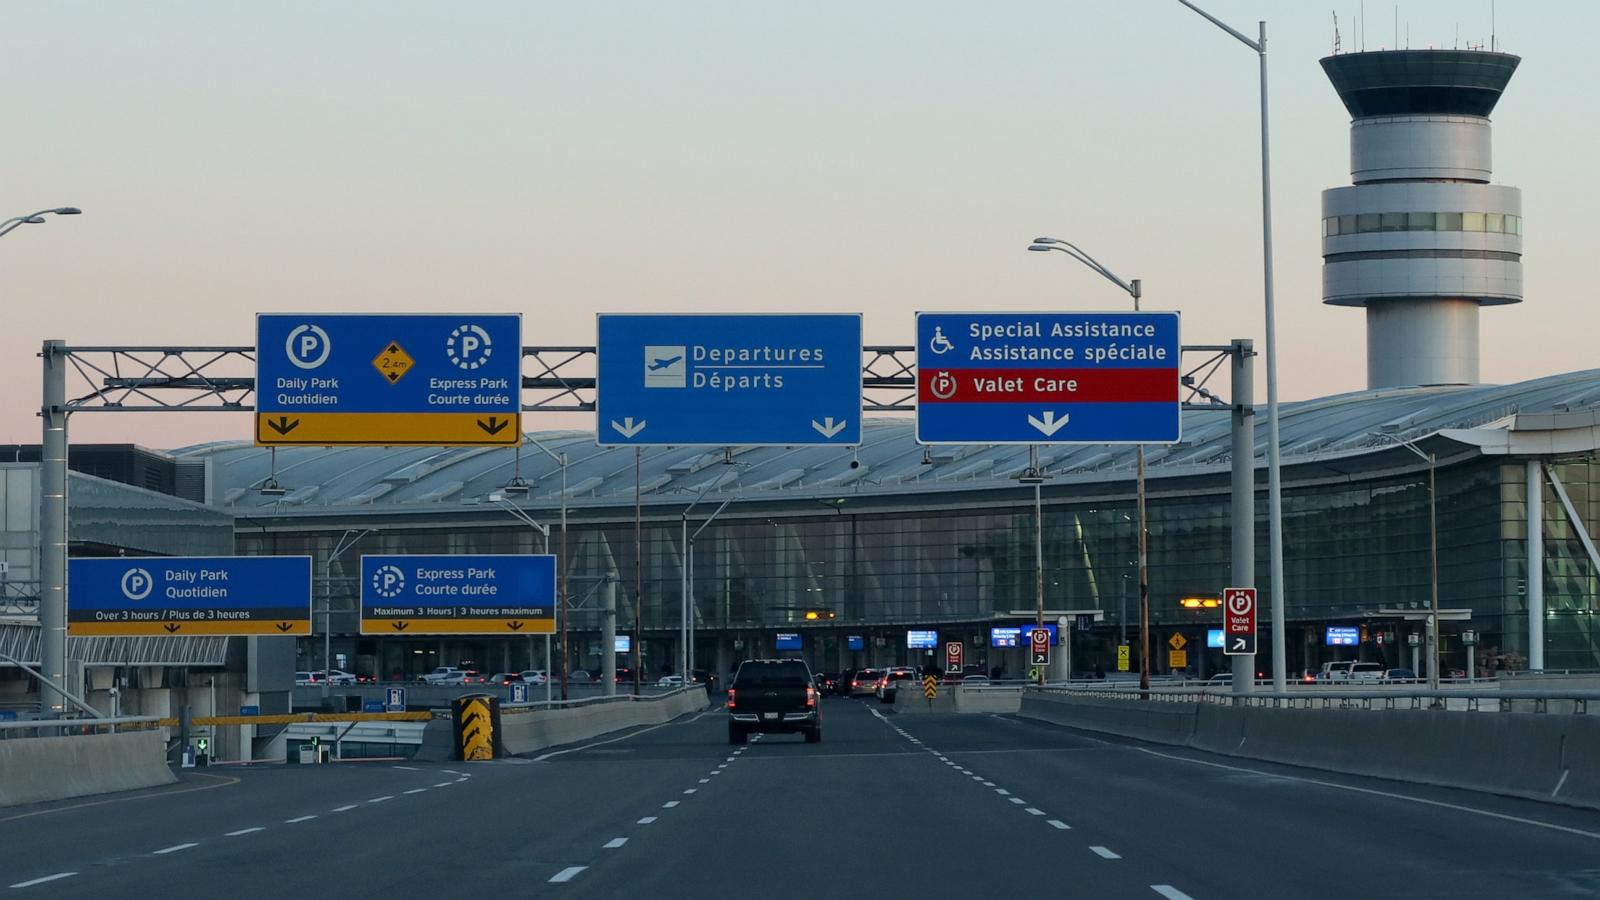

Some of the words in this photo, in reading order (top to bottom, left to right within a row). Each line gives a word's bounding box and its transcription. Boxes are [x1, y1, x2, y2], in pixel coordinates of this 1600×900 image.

[970, 322, 1041, 341] Special
[1051, 322, 1154, 337] Assistance
[302, 336, 317, 357] P
[463, 337, 478, 357] P
[694, 346, 822, 364] Departures
[970, 345, 1074, 360] Assistance
[1085, 345, 1167, 363] spéciale
[383, 358, 406, 368] 2.4m
[278, 378, 307, 390] Daily
[312, 378, 338, 388] Park
[430, 378, 477, 390] Express
[481, 378, 507, 388] Park
[694, 372, 783, 391] Départs
[939, 379, 950, 392] P
[974, 377, 1023, 392] Valet
[1034, 378, 1077, 391] Care
[278, 394, 337, 405] Quotidien
[428, 394, 470, 404] Courte
[474, 394, 509, 404] durée
[166, 570, 196, 583] Daily
[201, 570, 228, 580] Park
[417, 569, 464, 581] Express
[468, 568, 495, 578] Park
[132, 576, 144, 592] P
[385, 574, 395, 589] P
[166, 587, 227, 598] Quotidien
[416, 584, 458, 594] Courte
[462, 584, 497, 594] durée
[96, 611, 119, 620] Over
[122, 611, 128, 619] 3
[131, 611, 158, 619] hours
[170, 611, 190, 619] Plus
[193, 610, 205, 619] de
[208, 610, 214, 618] 3
[374, 608, 414, 616] Maximum
[461, 607, 466, 615] 3
[501, 608, 543, 616] maximum
